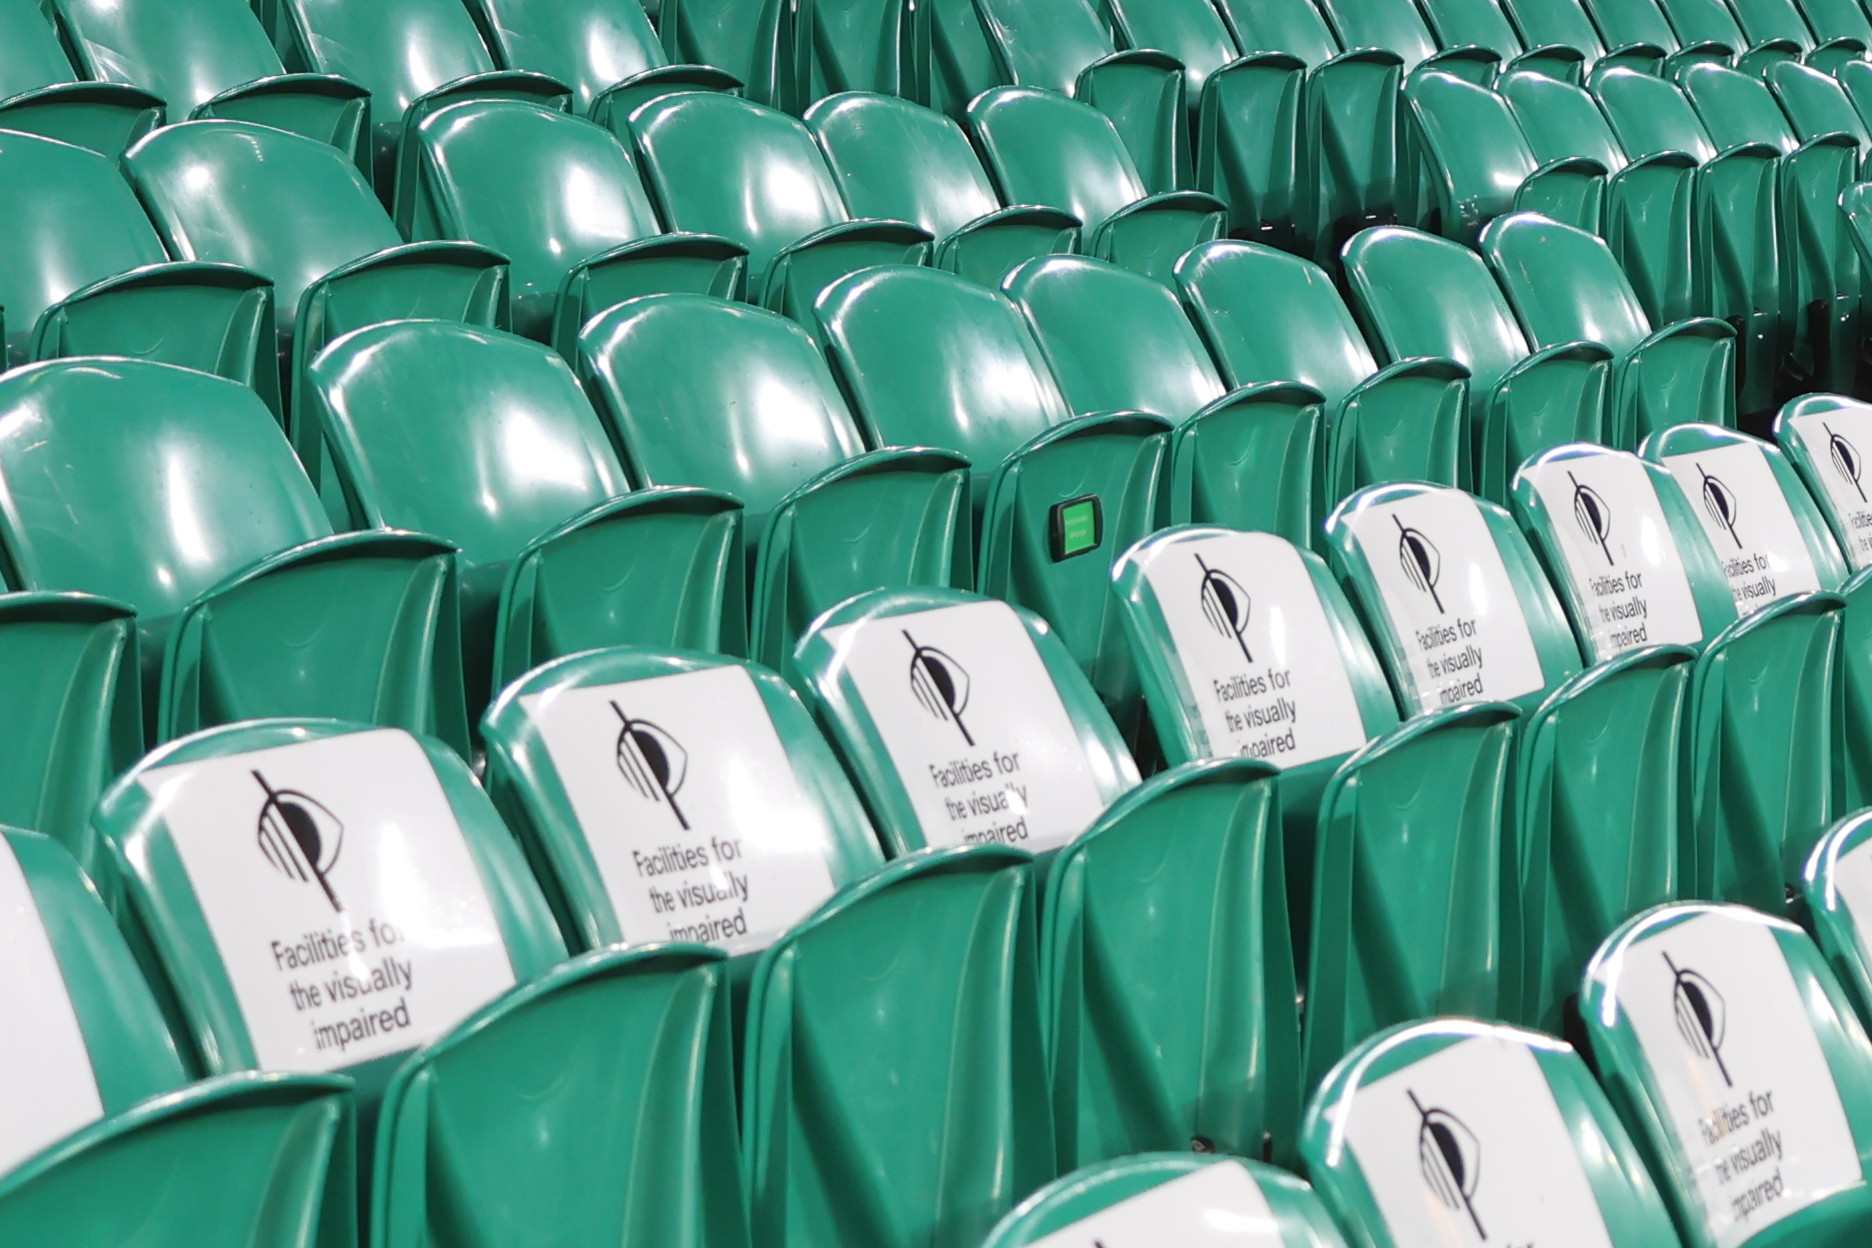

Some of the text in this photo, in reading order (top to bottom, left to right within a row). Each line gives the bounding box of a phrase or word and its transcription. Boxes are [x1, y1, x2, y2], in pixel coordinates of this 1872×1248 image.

[1625, 571, 1643, 590] for
[1611, 597, 1647, 621] visually
[1457, 618, 1477, 638] for
[1440, 645, 1482, 675] visually
[1213, 668, 1291, 702] Facilities for
[1440, 673, 1483, 704] mpaired
[1225, 697, 1296, 733] the visually
[929, 751, 1020, 789] Facilities for
[945, 797, 967, 821] the
[632, 836, 742, 877] Facilities for
[649, 885, 676, 914] the
[271, 928, 366, 971] Facilities
[289, 956, 412, 1011] the visually
[310, 996, 411, 1052] impaired
[1749, 1090, 1775, 1119] for
[1731, 1128, 1783, 1175] visually
